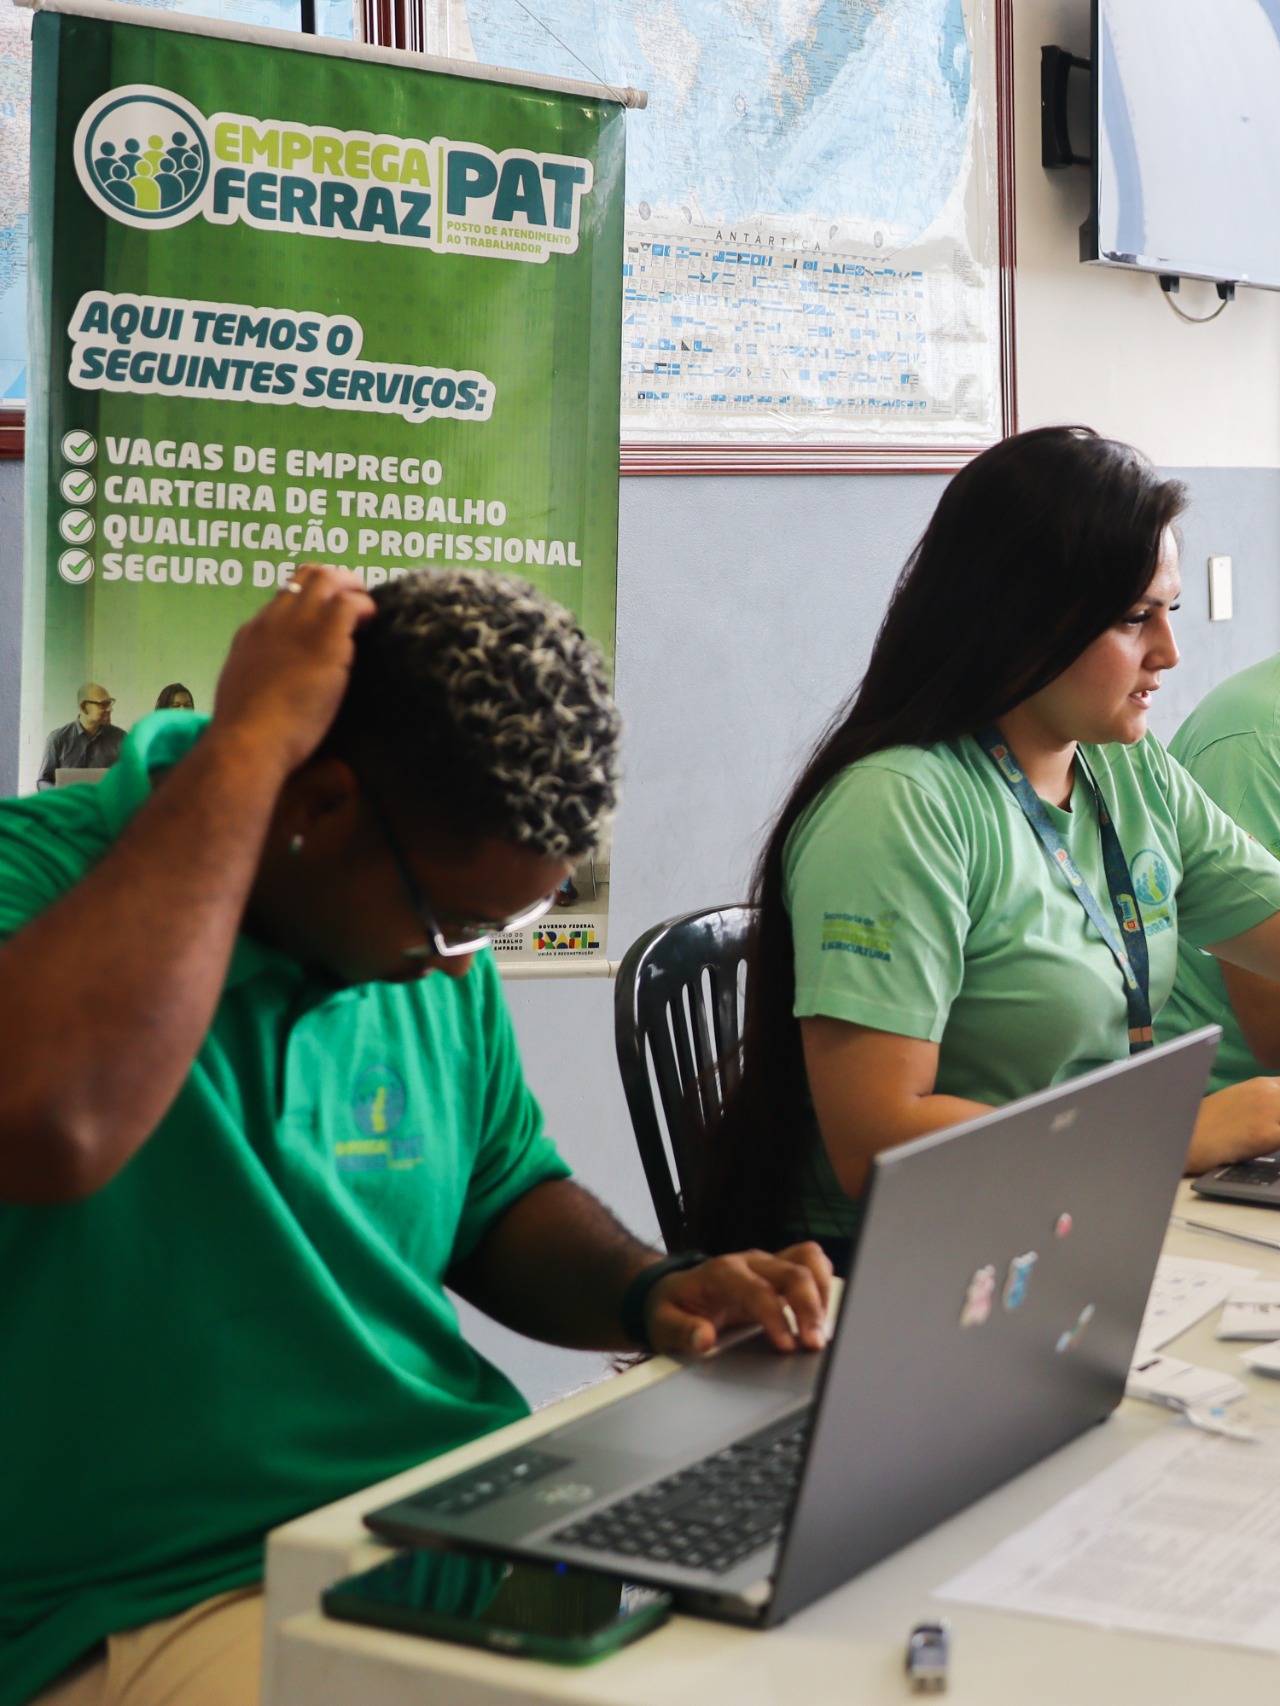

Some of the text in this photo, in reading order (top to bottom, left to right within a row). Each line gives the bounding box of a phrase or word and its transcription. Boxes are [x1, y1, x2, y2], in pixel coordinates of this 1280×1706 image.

[214, 122, 431, 188] EMPREGA
[213, 167, 431, 239] FERRAZ
[447, 149, 586, 230] PAT
[447, 221, 572, 245] POSTO DE ATENDIMENTO
[447, 234, 543, 254] AO TRABALHADOR
[79, 301, 354, 356] AQUI TEMOS O
[79, 346, 488, 414] SEGUINTES SERVIÇOS:
[105, 436, 443, 486] VAGAS DE EMPREGO
[104, 475, 507, 527] CARTEIRA DE TRABALHO
[103, 514, 582, 567] QUALIFICAÇÃO PROFISSIONAL
[102, 553, 243, 586] SEGURO
[533, 930, 600, 950] BRASIL
